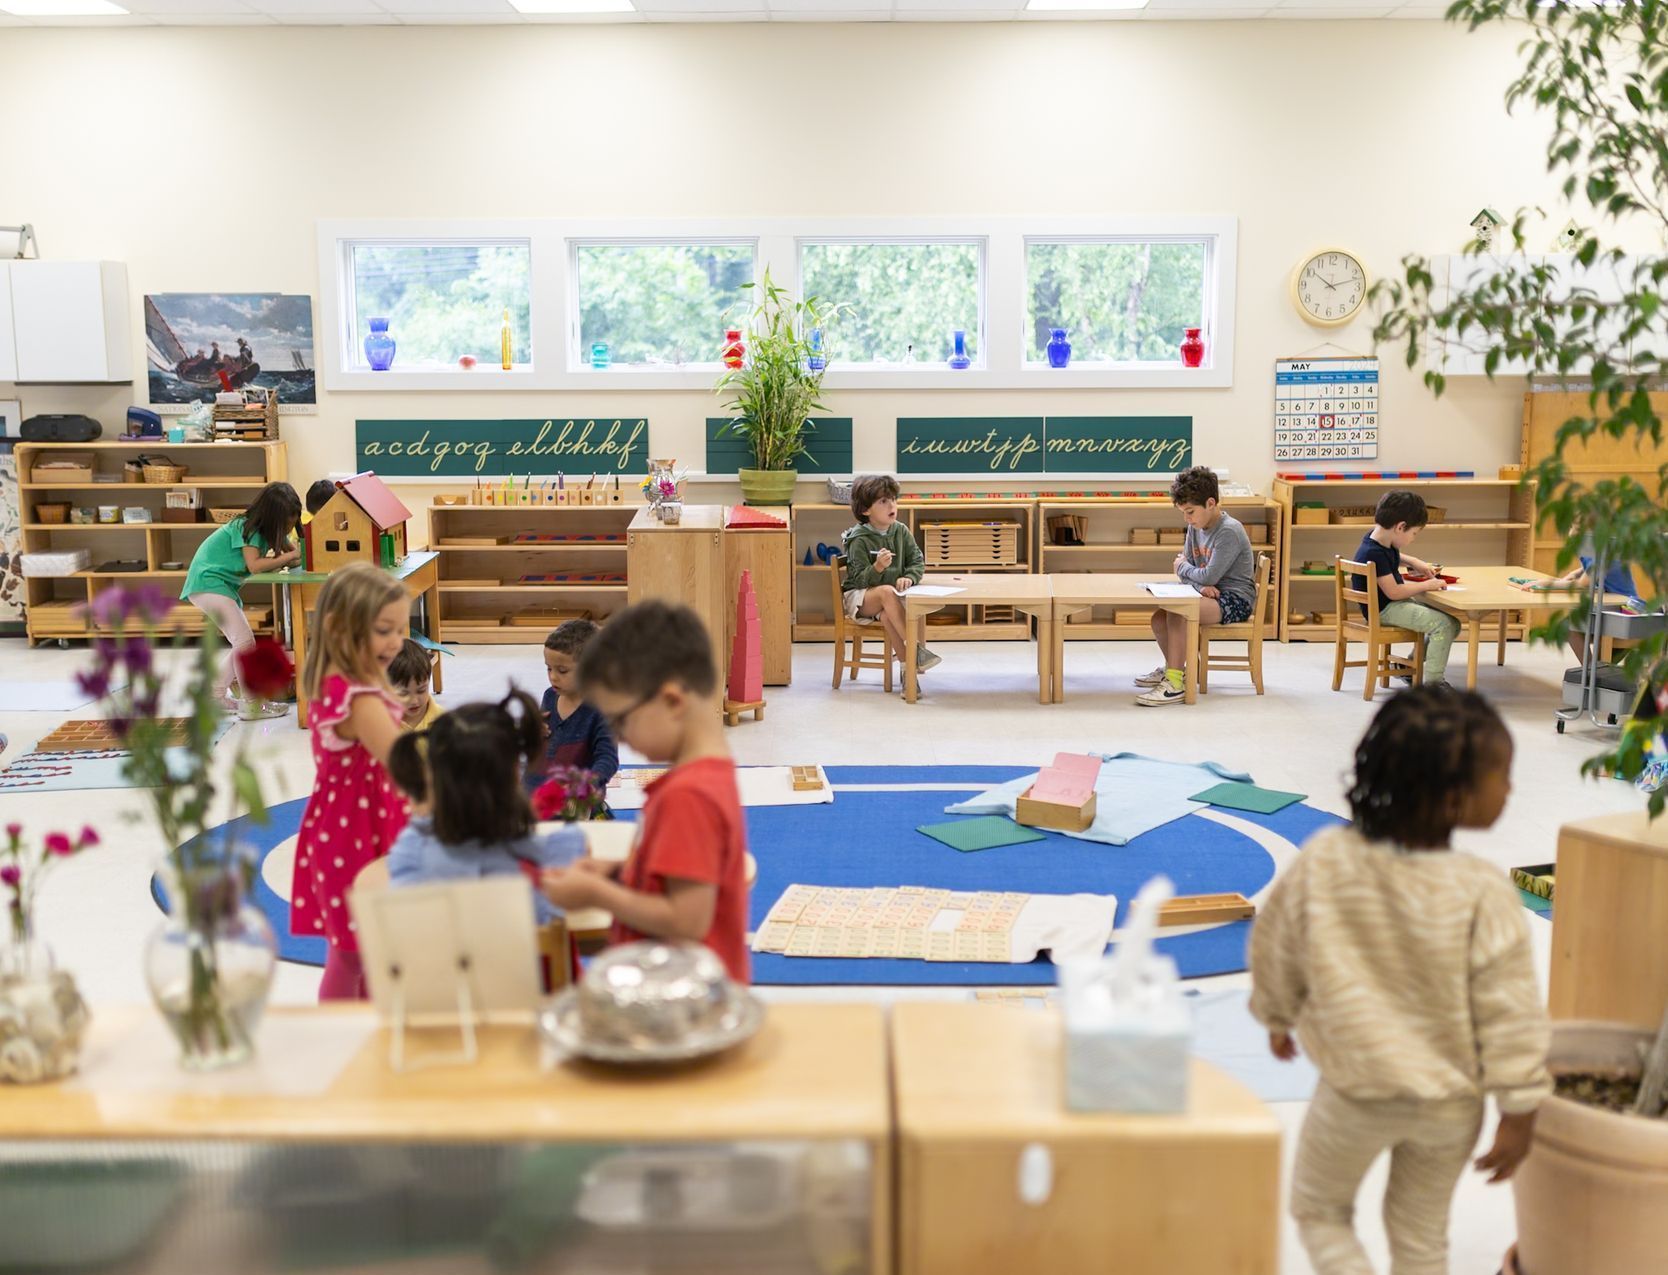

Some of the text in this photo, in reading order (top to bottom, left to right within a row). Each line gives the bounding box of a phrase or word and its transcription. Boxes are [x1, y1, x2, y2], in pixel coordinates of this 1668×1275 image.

[1318, 259, 1323, 268] 11
[1329, 255, 1337, 265] 12
[1345, 260, 1348, 270] 1
[1307, 268, 1315, 278] 10
[1352, 269, 1359, 279] 2
[1301, 281, 1306, 289] 9
[1354, 283, 1360, 292] 3
[1305, 294, 1311, 303] 8
[1349, 295, 1355, 304] 4
[1315, 304, 1320, 313] 7
[1326, 307, 1331, 317] 6
[1340, 304, 1345, 313] 5
[1291, 363, 1310, 371] MAY
[1280, 403, 1285, 411] 5
[1293, 418, 1301, 426] 13
[1352, 447, 1360, 455] 31
